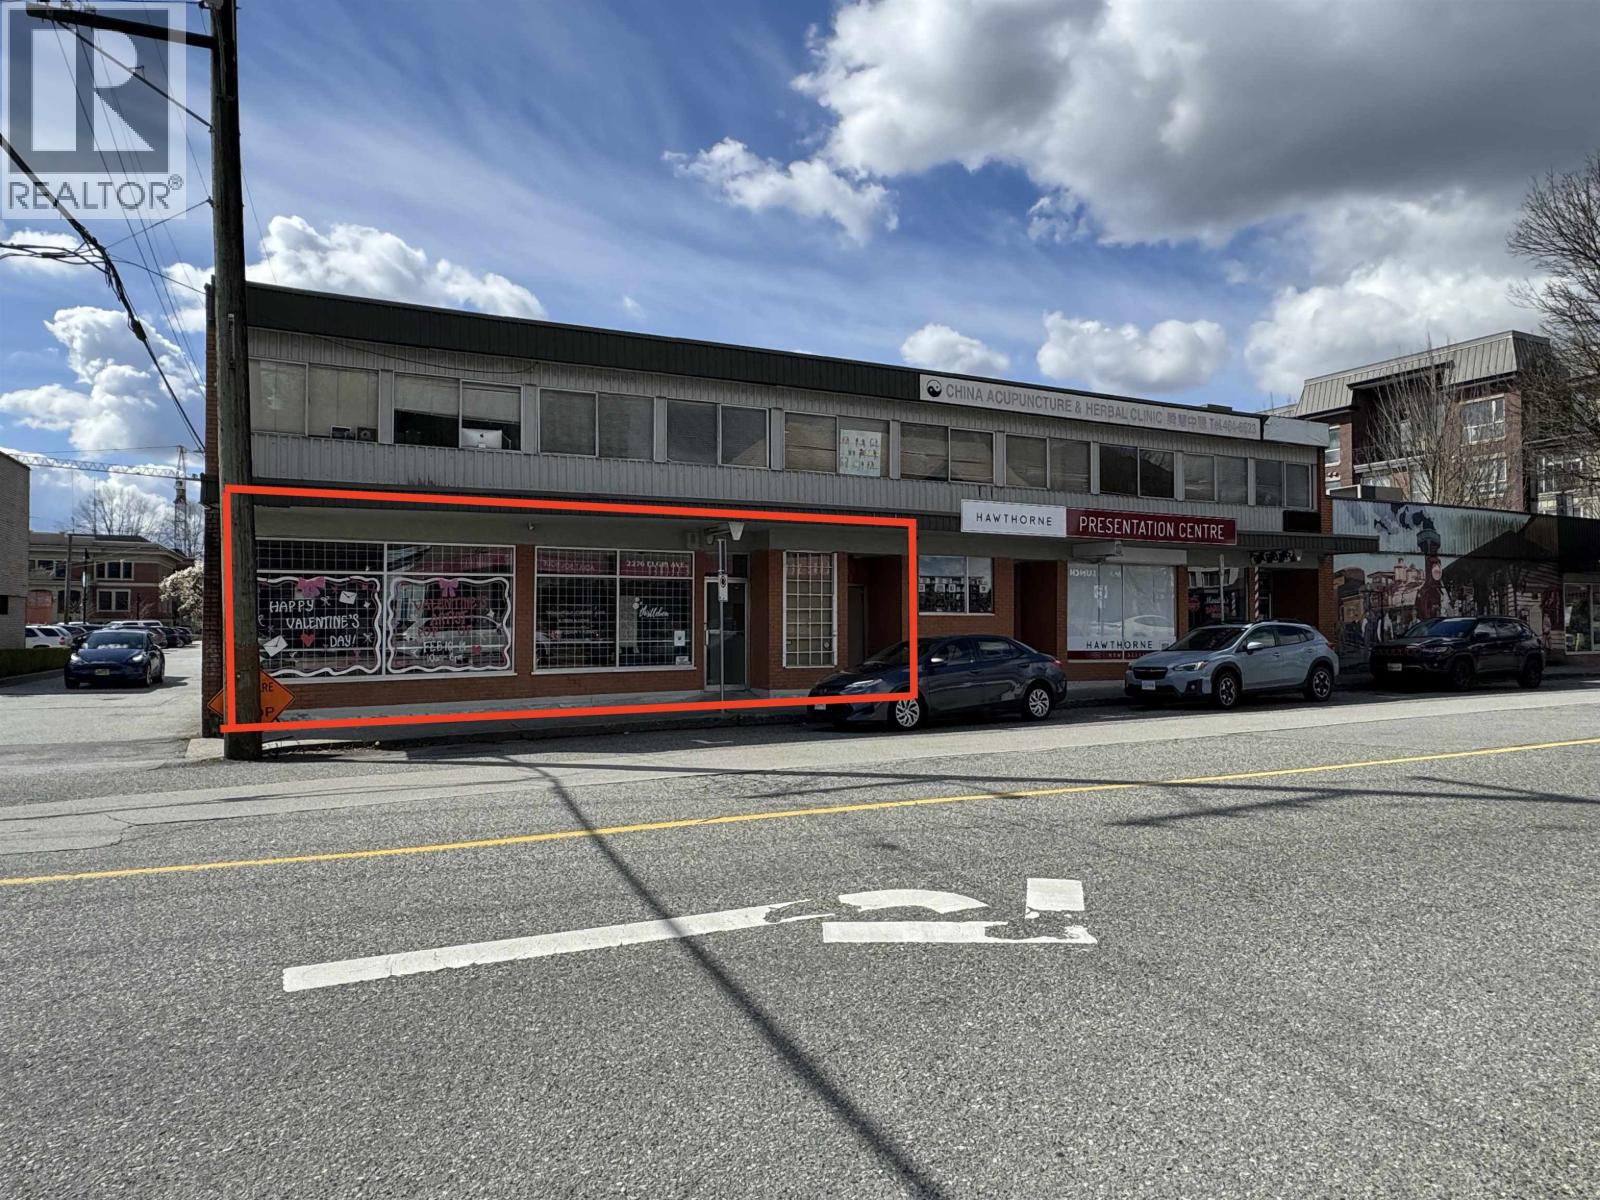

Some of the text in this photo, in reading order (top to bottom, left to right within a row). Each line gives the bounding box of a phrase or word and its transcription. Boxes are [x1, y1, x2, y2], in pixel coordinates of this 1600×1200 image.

[945, 384, 1163, 424] CHINA ACUPUNCTURE & HERBAL CLINIC
[976, 512, 1052, 527] HAWTHORNE
[1079, 516, 1225, 541] PRESENTATION CENTRE
[269, 599, 314, 613] HAPPY
[286, 614, 360, 630] VALENTINE'S
[329, 635, 357, 648] DAY!
[1086, 640, 1153, 650] HAWTHORNE
